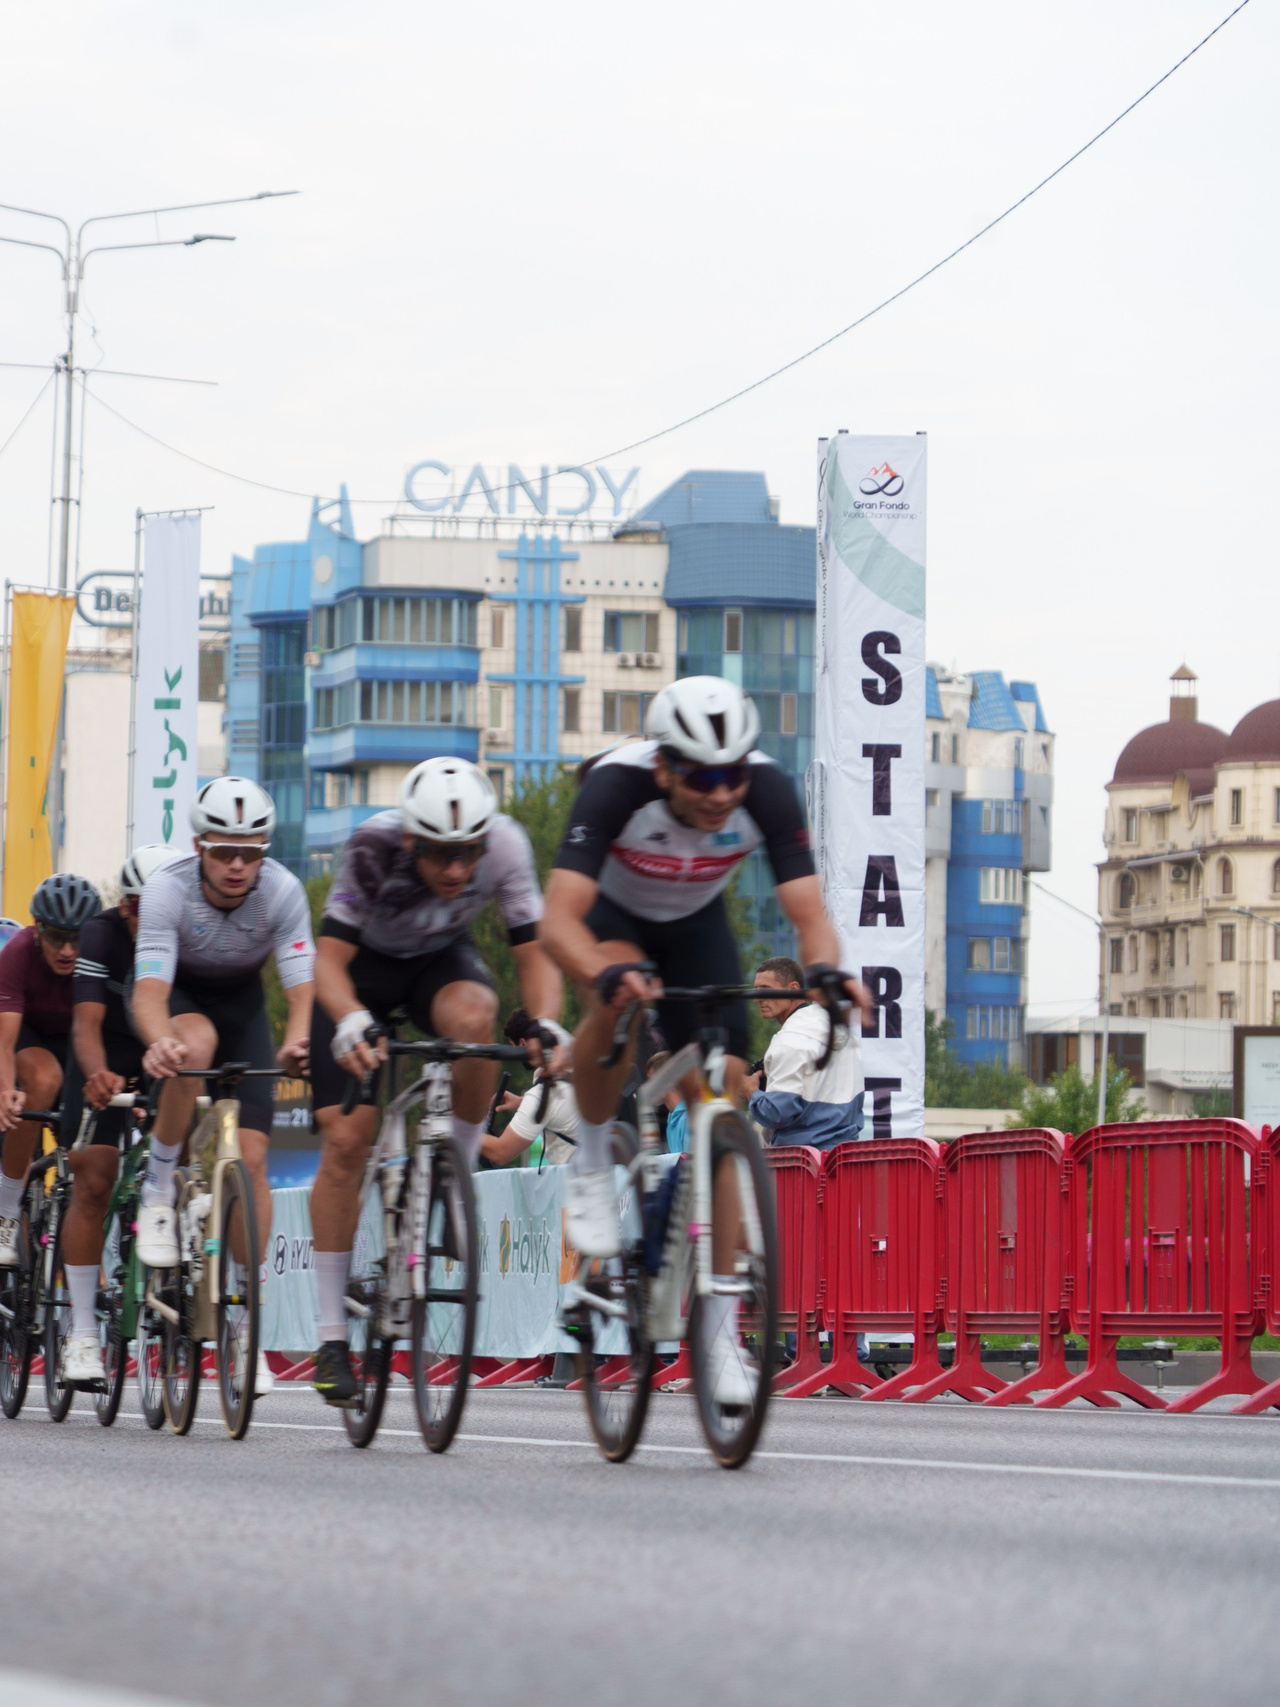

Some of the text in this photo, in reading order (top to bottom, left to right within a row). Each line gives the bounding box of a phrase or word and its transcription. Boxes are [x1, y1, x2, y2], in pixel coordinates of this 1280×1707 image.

[403, 459, 641, 517] CANDY
[853, 500, 910, 510] Gran Fondo
[512, 1216, 552, 1286] Halyk
